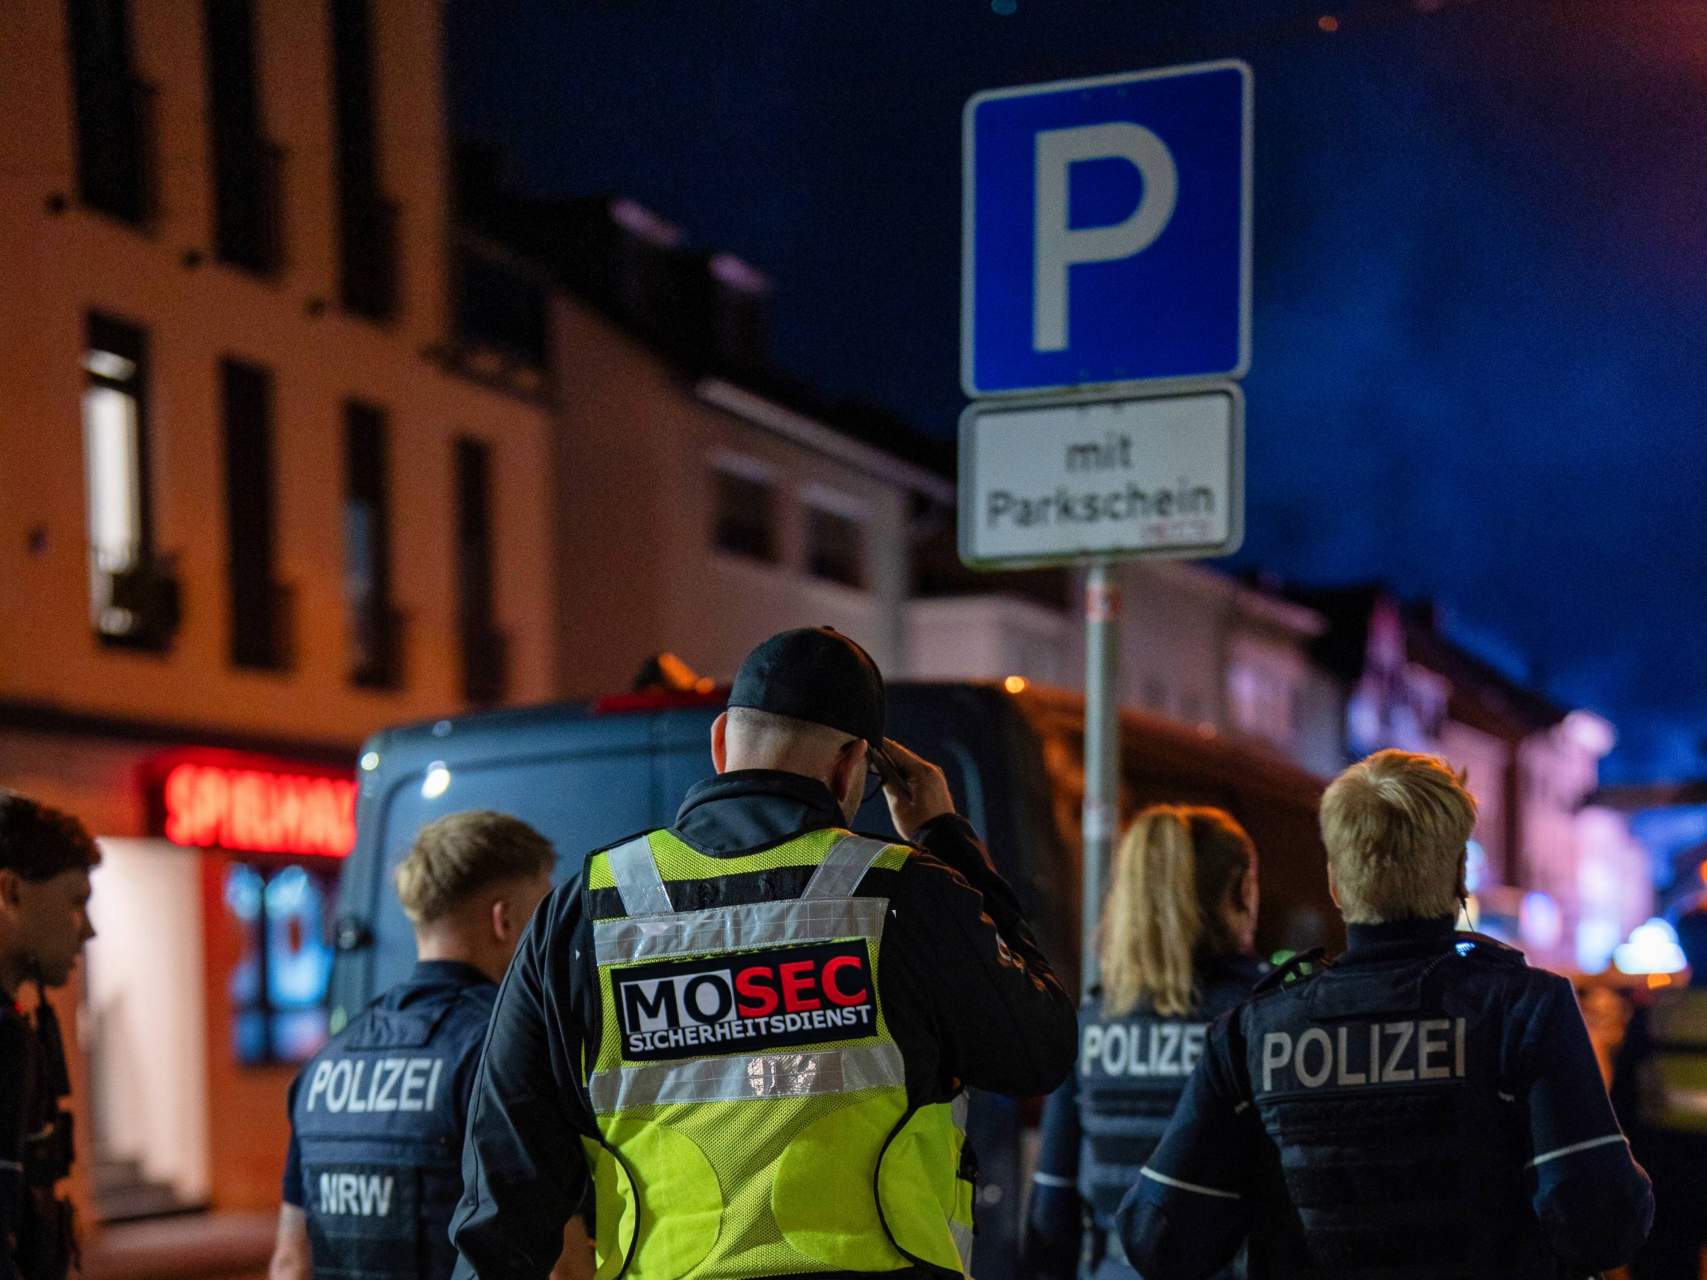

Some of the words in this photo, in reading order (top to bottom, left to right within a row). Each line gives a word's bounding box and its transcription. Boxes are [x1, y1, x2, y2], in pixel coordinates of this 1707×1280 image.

[1033, 121, 1179, 353] P
[1065, 431, 1132, 473] mit
[987, 476, 1215, 530] Parkschein
[622, 955, 868, 1034] MOSEC
[629, 1004, 872, 1051] SICHERHEITSDIENST
[1080, 1022, 1207, 1077] POLIZE
[1262, 1017, 1466, 1092] POLIZEI
[306, 1058, 443, 1113] POLIZEI
[319, 1172, 394, 1217] NRW
